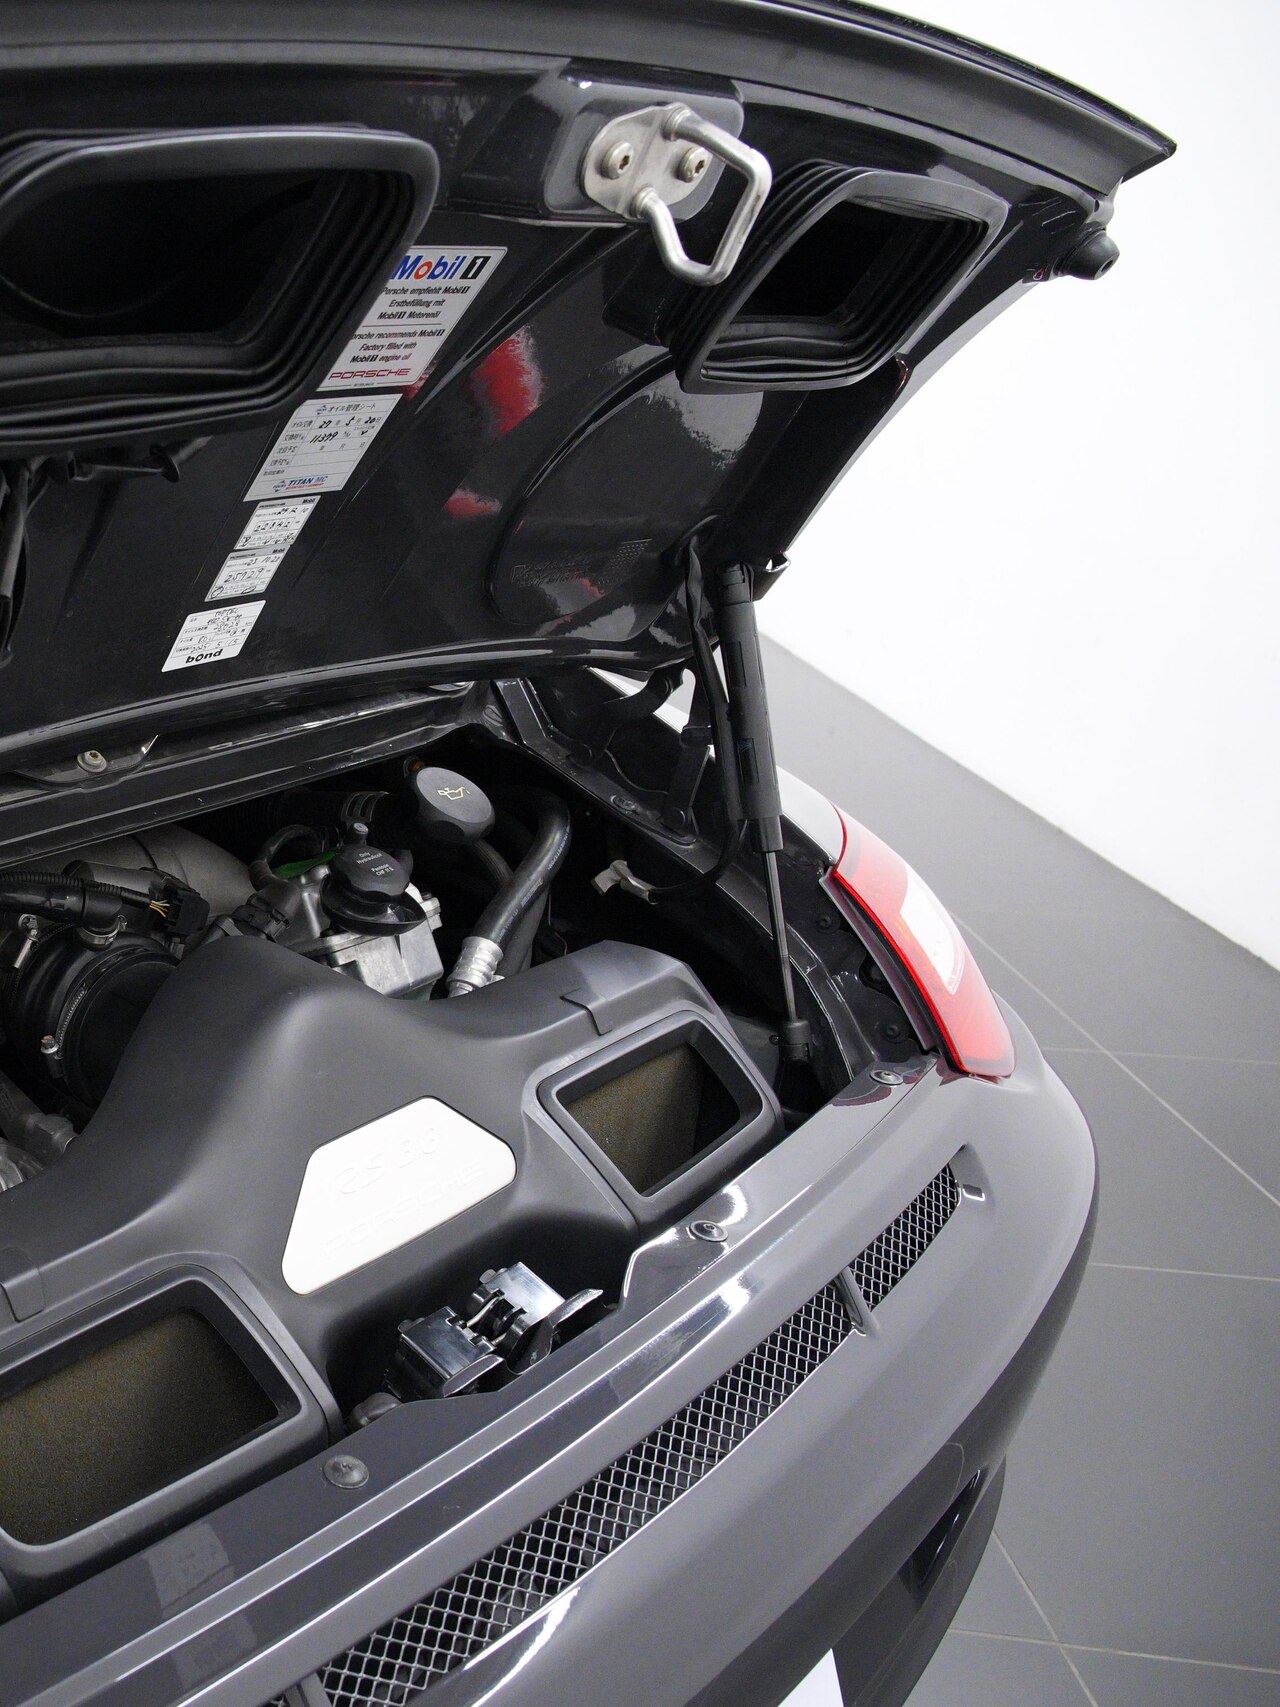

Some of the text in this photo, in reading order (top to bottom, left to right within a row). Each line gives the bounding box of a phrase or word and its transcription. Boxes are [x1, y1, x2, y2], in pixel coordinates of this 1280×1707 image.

[391, 255, 488, 280] Mobil 1
[409, 286, 442, 296] empfiehlt
[442, 286, 461, 295] Mobil
[389, 299, 446, 308] Erstbefüllung mit
[377, 311, 398, 320] Mobil
[406, 310, 441, 319] Motorenöl
[351, 331, 375, 340] orsche
[375, 329, 418, 339] recommends
[419, 328, 437, 337] Mobil
[358, 341, 417, 352] Factory filled with
[350, 354, 370, 363] Mobil
[378, 353, 400, 363] engine
[401, 352, 412, 361] oil
[328, 367, 412, 381] PORSCHE
[288, 477, 314, 487] TITAN
[333, 1150, 388, 1201] RS
[320, 1158, 484, 1257] PORSCHE
